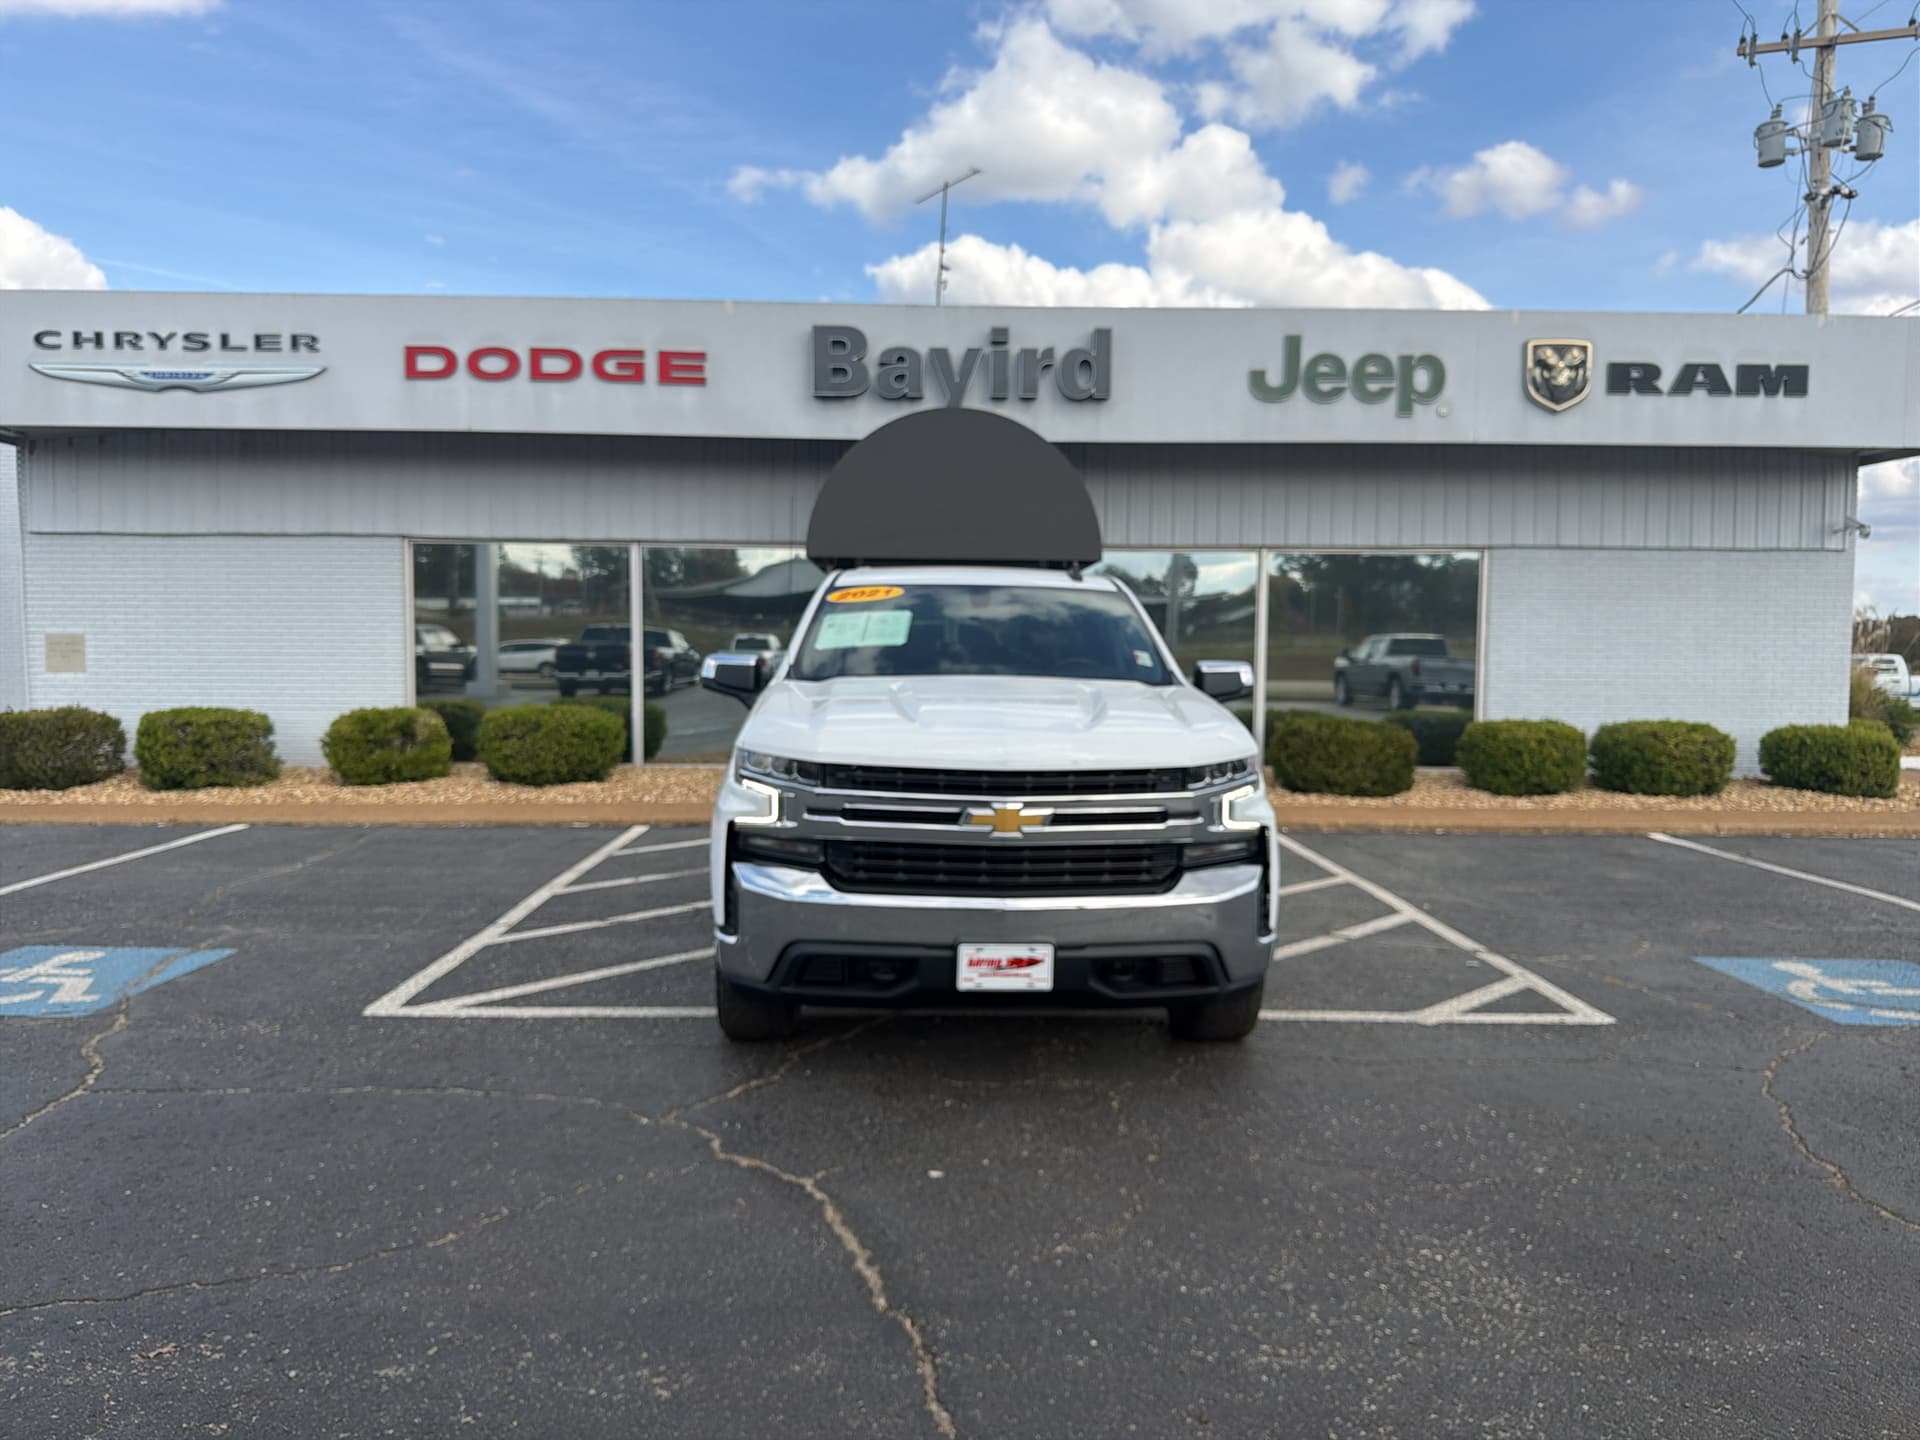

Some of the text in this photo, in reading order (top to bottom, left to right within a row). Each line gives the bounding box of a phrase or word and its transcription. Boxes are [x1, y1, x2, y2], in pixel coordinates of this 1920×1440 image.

[34, 330, 320, 352] CHRYSLER
[404, 345, 708, 385] DODGE
[811, 325, 1113, 408] Bayird
[1248, 334, 1447, 418] Jeep
[1606, 362, 1809, 396] RAM
[835, 588, 894, 601] 2021
